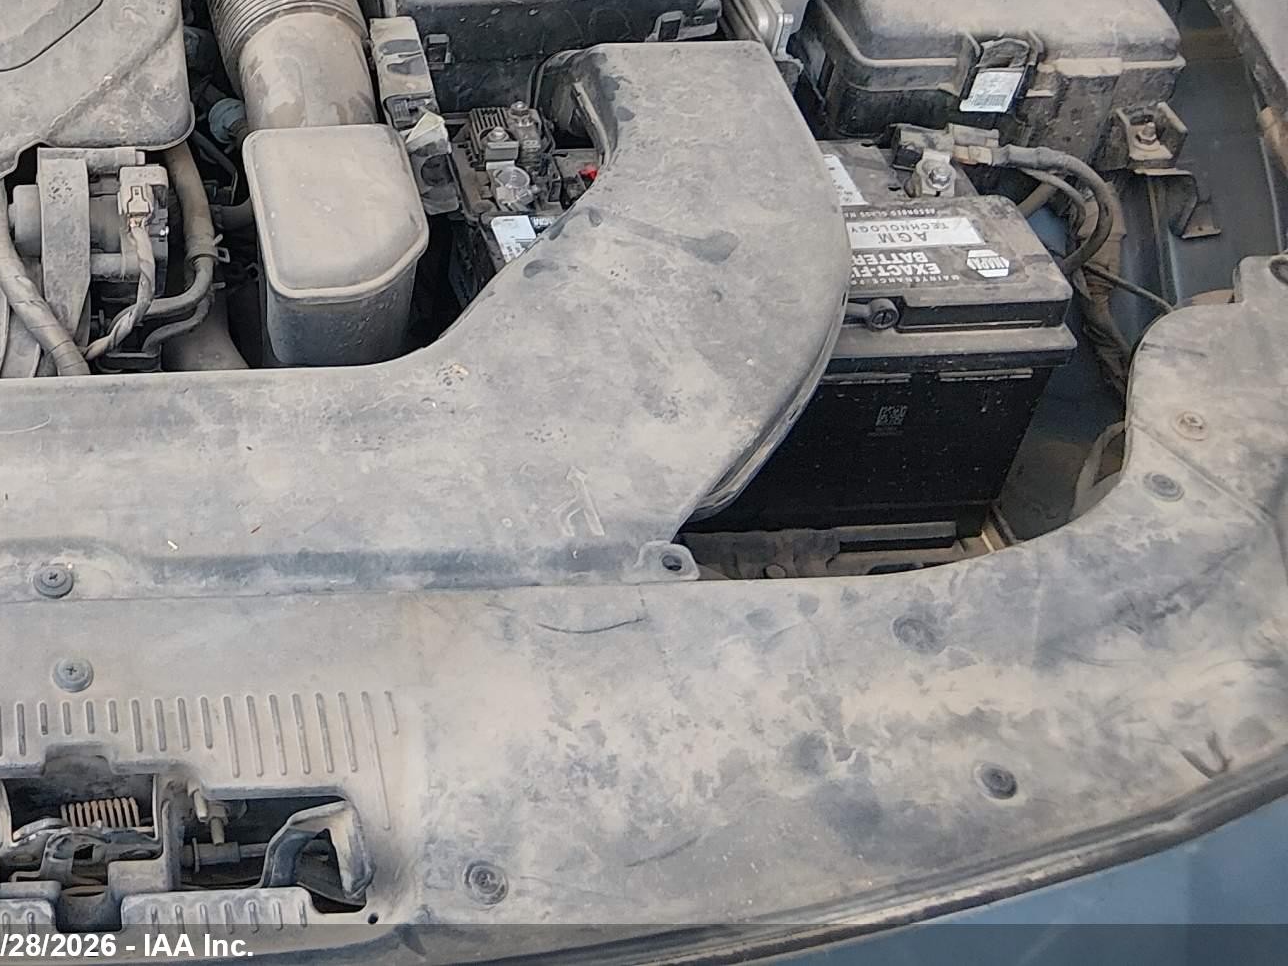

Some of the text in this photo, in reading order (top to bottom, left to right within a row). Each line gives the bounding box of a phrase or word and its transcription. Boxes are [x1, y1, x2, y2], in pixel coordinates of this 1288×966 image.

[851, 222, 950, 234] TECHNOLOGY
[877, 232, 928, 244] AGM
[851, 251, 929, 266] BATTER
[970, 256, 1010, 270] NAPA
[872, 274, 961, 285] MAINTENANCE
